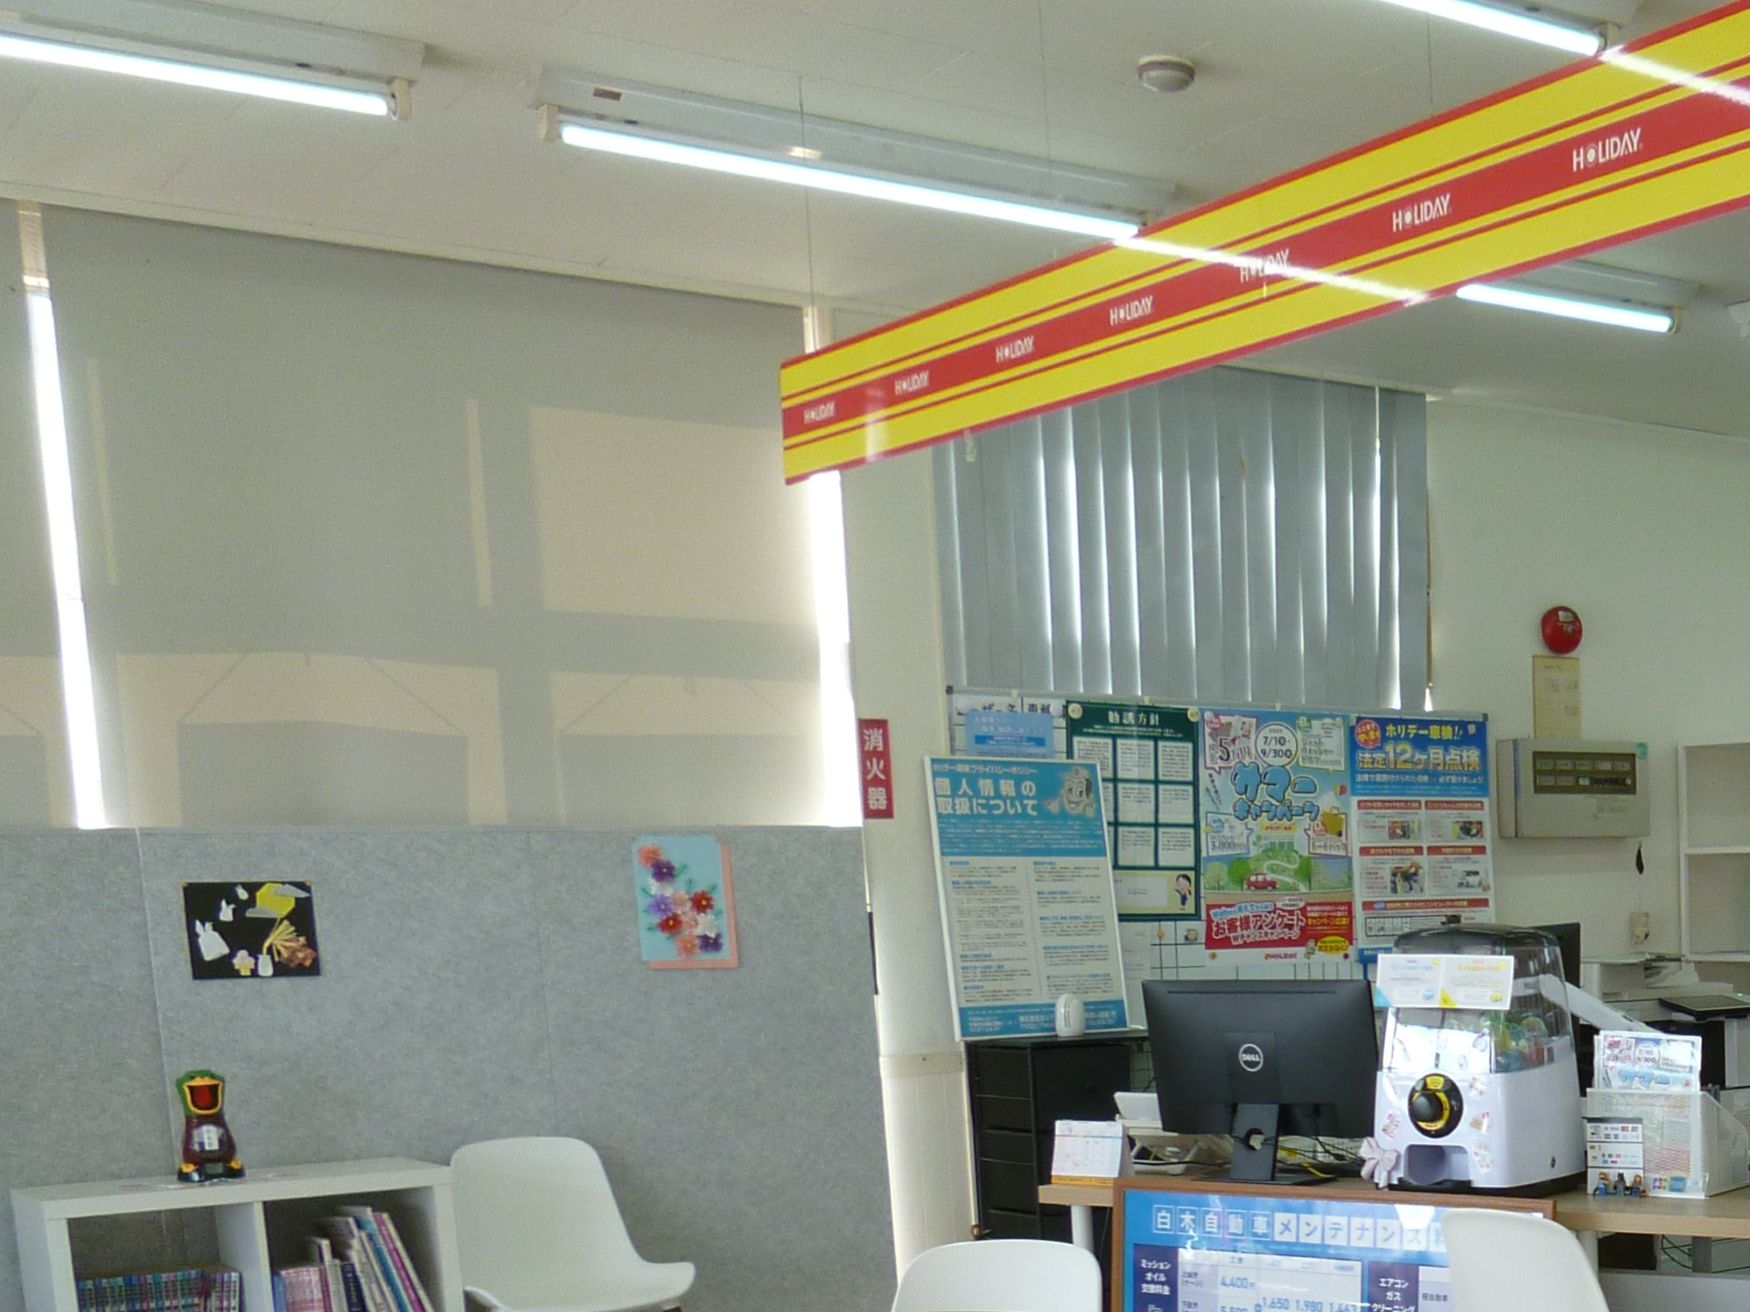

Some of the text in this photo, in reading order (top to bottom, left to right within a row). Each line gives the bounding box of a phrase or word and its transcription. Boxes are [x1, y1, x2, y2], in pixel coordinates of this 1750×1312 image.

[1573, 128, 1644, 172] HOLIDAY
[1392, 194, 1452, 233] HOLIDAY
[1109, 296, 1154, 326] HOLIDAY
[995, 335, 1035, 363] HOLIDAY
[895, 370, 930, 396] HOLIDAY
[863, 727, 888, 810] 消火器
[935, 777, 1037, 797] 個人情報の
[1230, 761, 1318, 804] サマー
[936, 797, 1038, 815] 取扱について
[1233, 798, 1320, 822] キャンペーン
[1212, 910, 1306, 939] お客様アンケート
[1145, 1272, 1167, 1282] オイル
[1379, 1278, 1409, 1288] エアコン
[1295, 1299, 1324, 1312] 1,980
[1385, 1291, 1402, 1300] ガス
